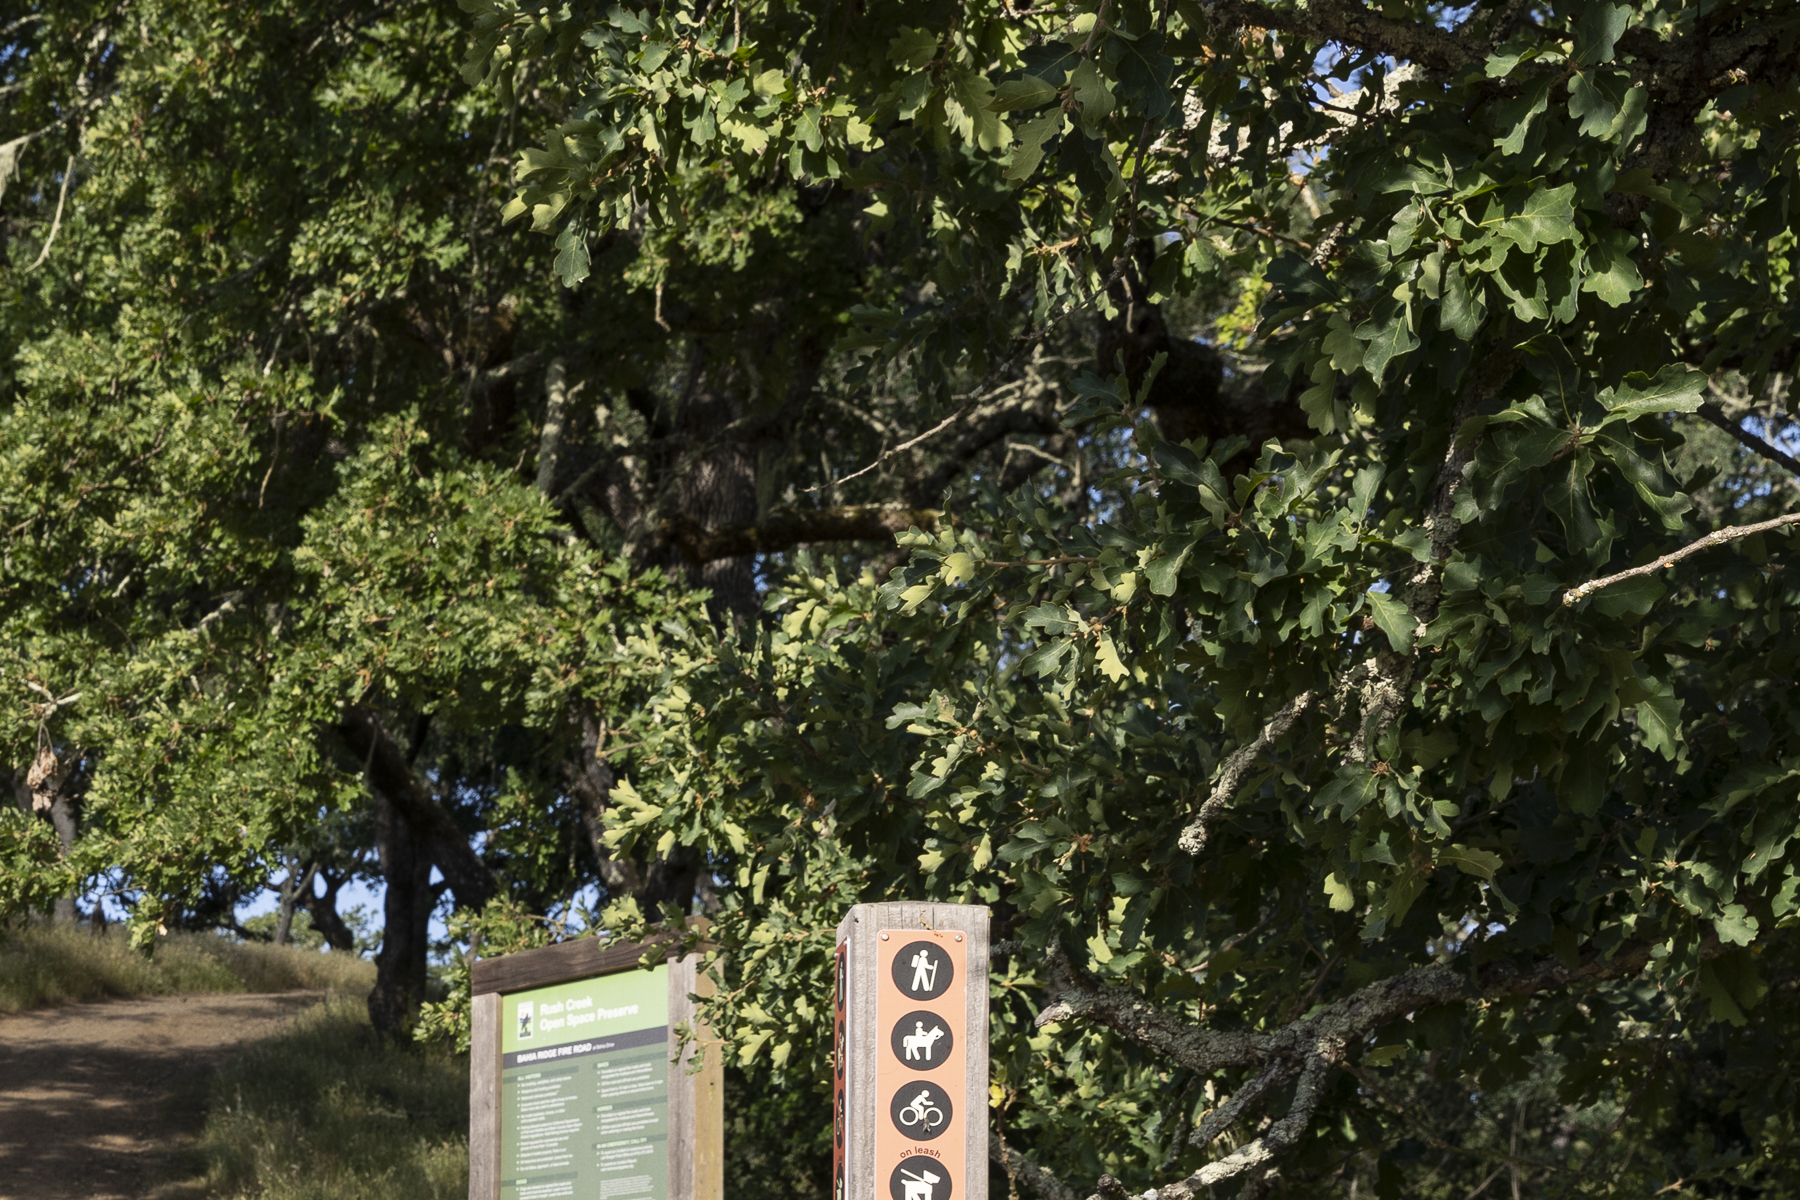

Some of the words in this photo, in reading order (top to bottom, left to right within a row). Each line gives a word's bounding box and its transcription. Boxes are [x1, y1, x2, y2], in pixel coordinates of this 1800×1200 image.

[540, 1001, 564, 1016] Rush
[566, 996, 593, 1011] Creek
[540, 1016, 565, 1032] Open
[566, 1011, 595, 1028] Space
[597, 1004, 639, 1021] Preserve
[517, 1052, 537, 1064] BAHIA
[537, 1049, 557, 1060] RIDGE
[558, 1046, 572, 1057] FIRE
[573, 1042, 592, 1054] ROAD
[900, 1149, 912, 1158] on
[914, 1146, 941, 1159] leash
